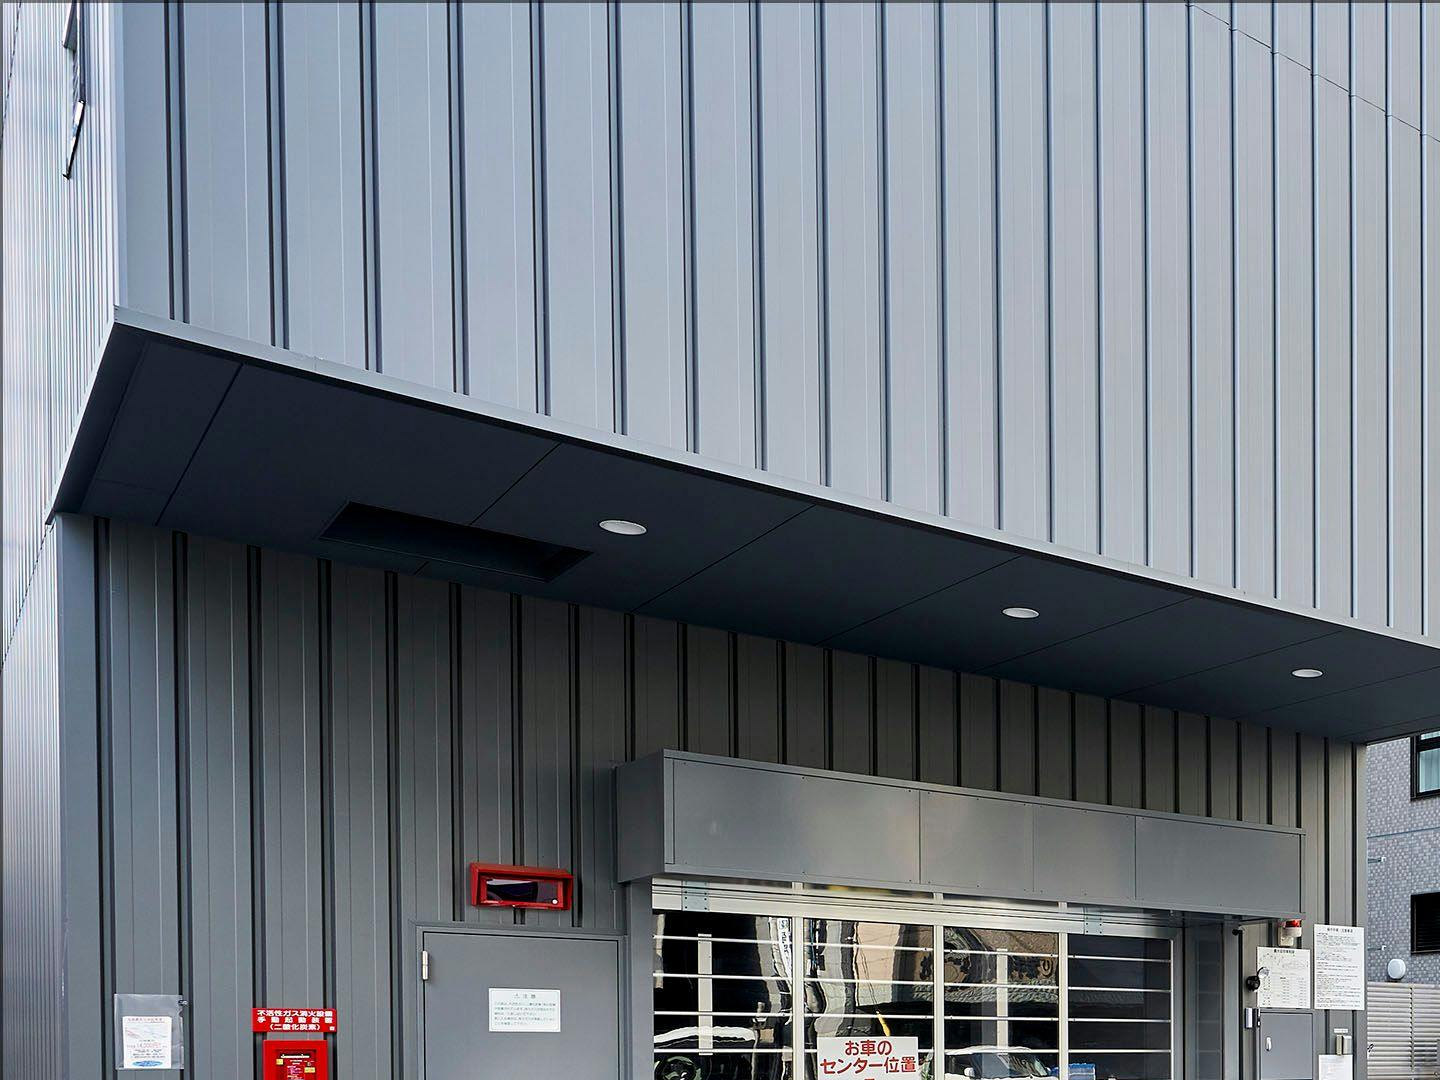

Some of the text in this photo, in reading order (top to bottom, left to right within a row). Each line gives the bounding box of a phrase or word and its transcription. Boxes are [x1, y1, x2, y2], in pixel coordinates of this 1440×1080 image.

[845, 1040, 892, 1056] お車の
[820, 1057, 916, 1074] センター位置
